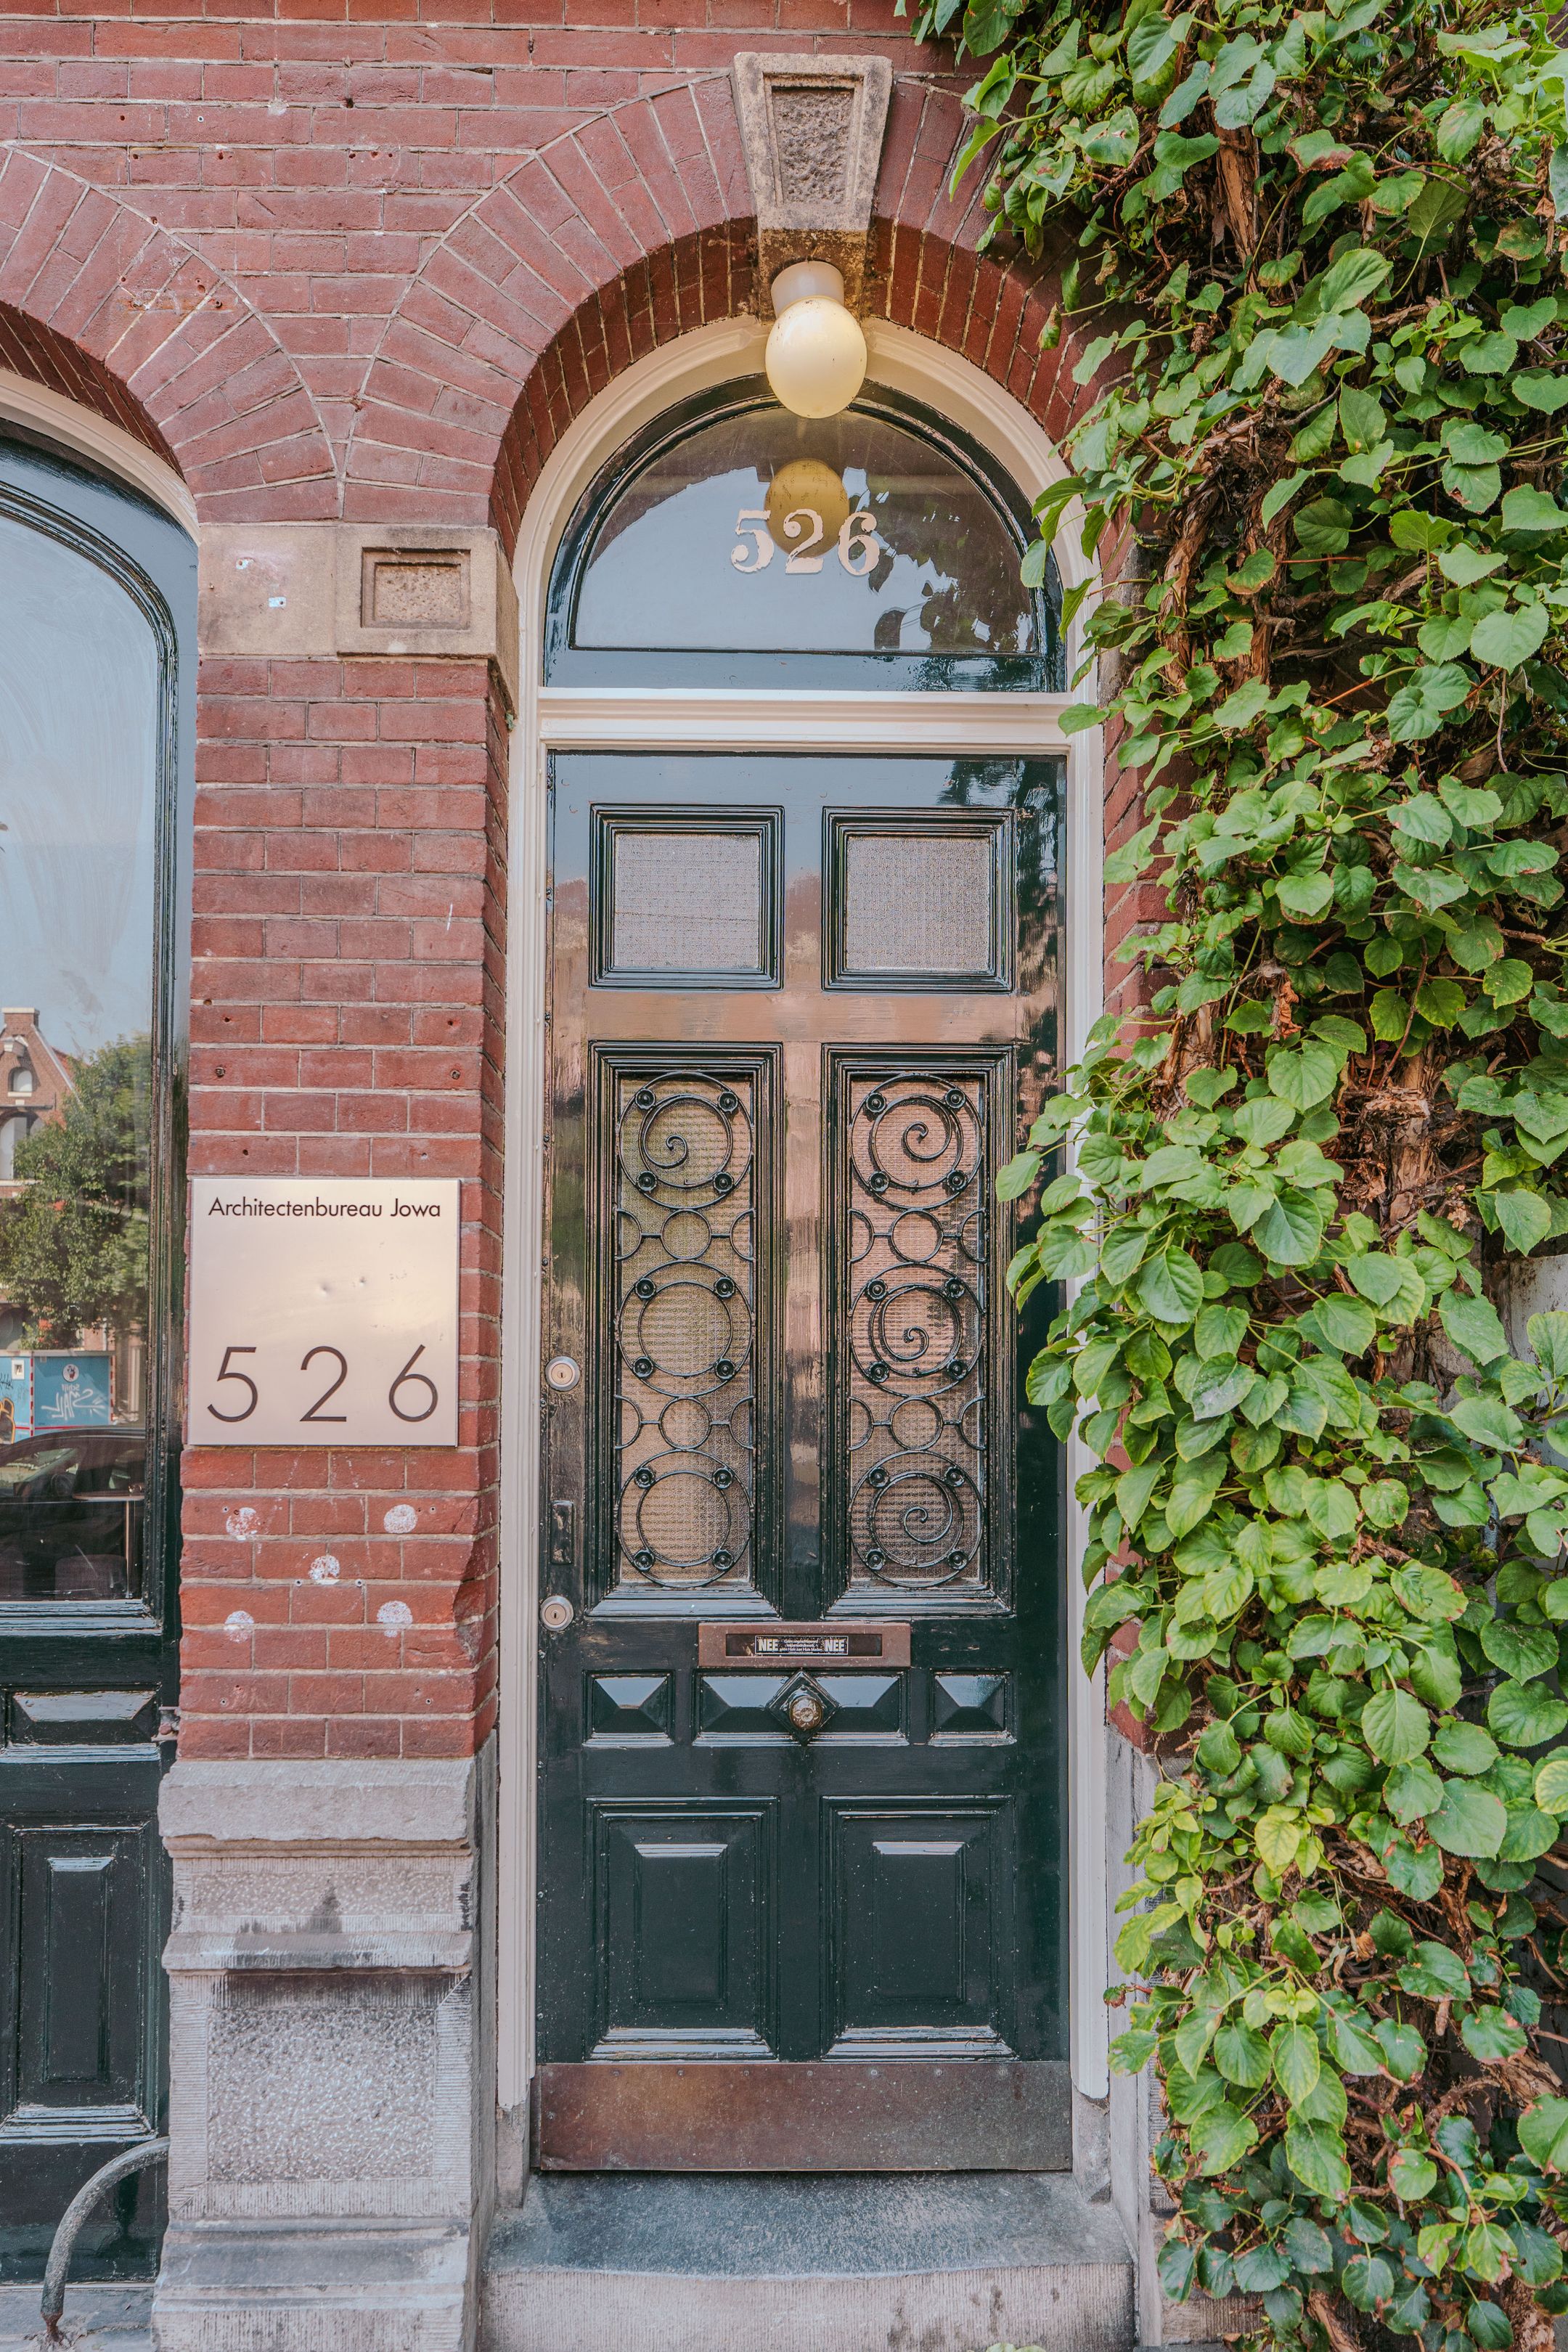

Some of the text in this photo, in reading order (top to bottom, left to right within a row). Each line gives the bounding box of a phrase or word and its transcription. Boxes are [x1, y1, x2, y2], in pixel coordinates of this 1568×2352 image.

[731, 508, 881, 576] 526
[208, 1196, 441, 1217] Architectenbureau Jowa
[207, 1344, 438, 1423] 526
[759, 1638, 779, 1651] NEE
[825, 1639, 845, 1651] NEE
